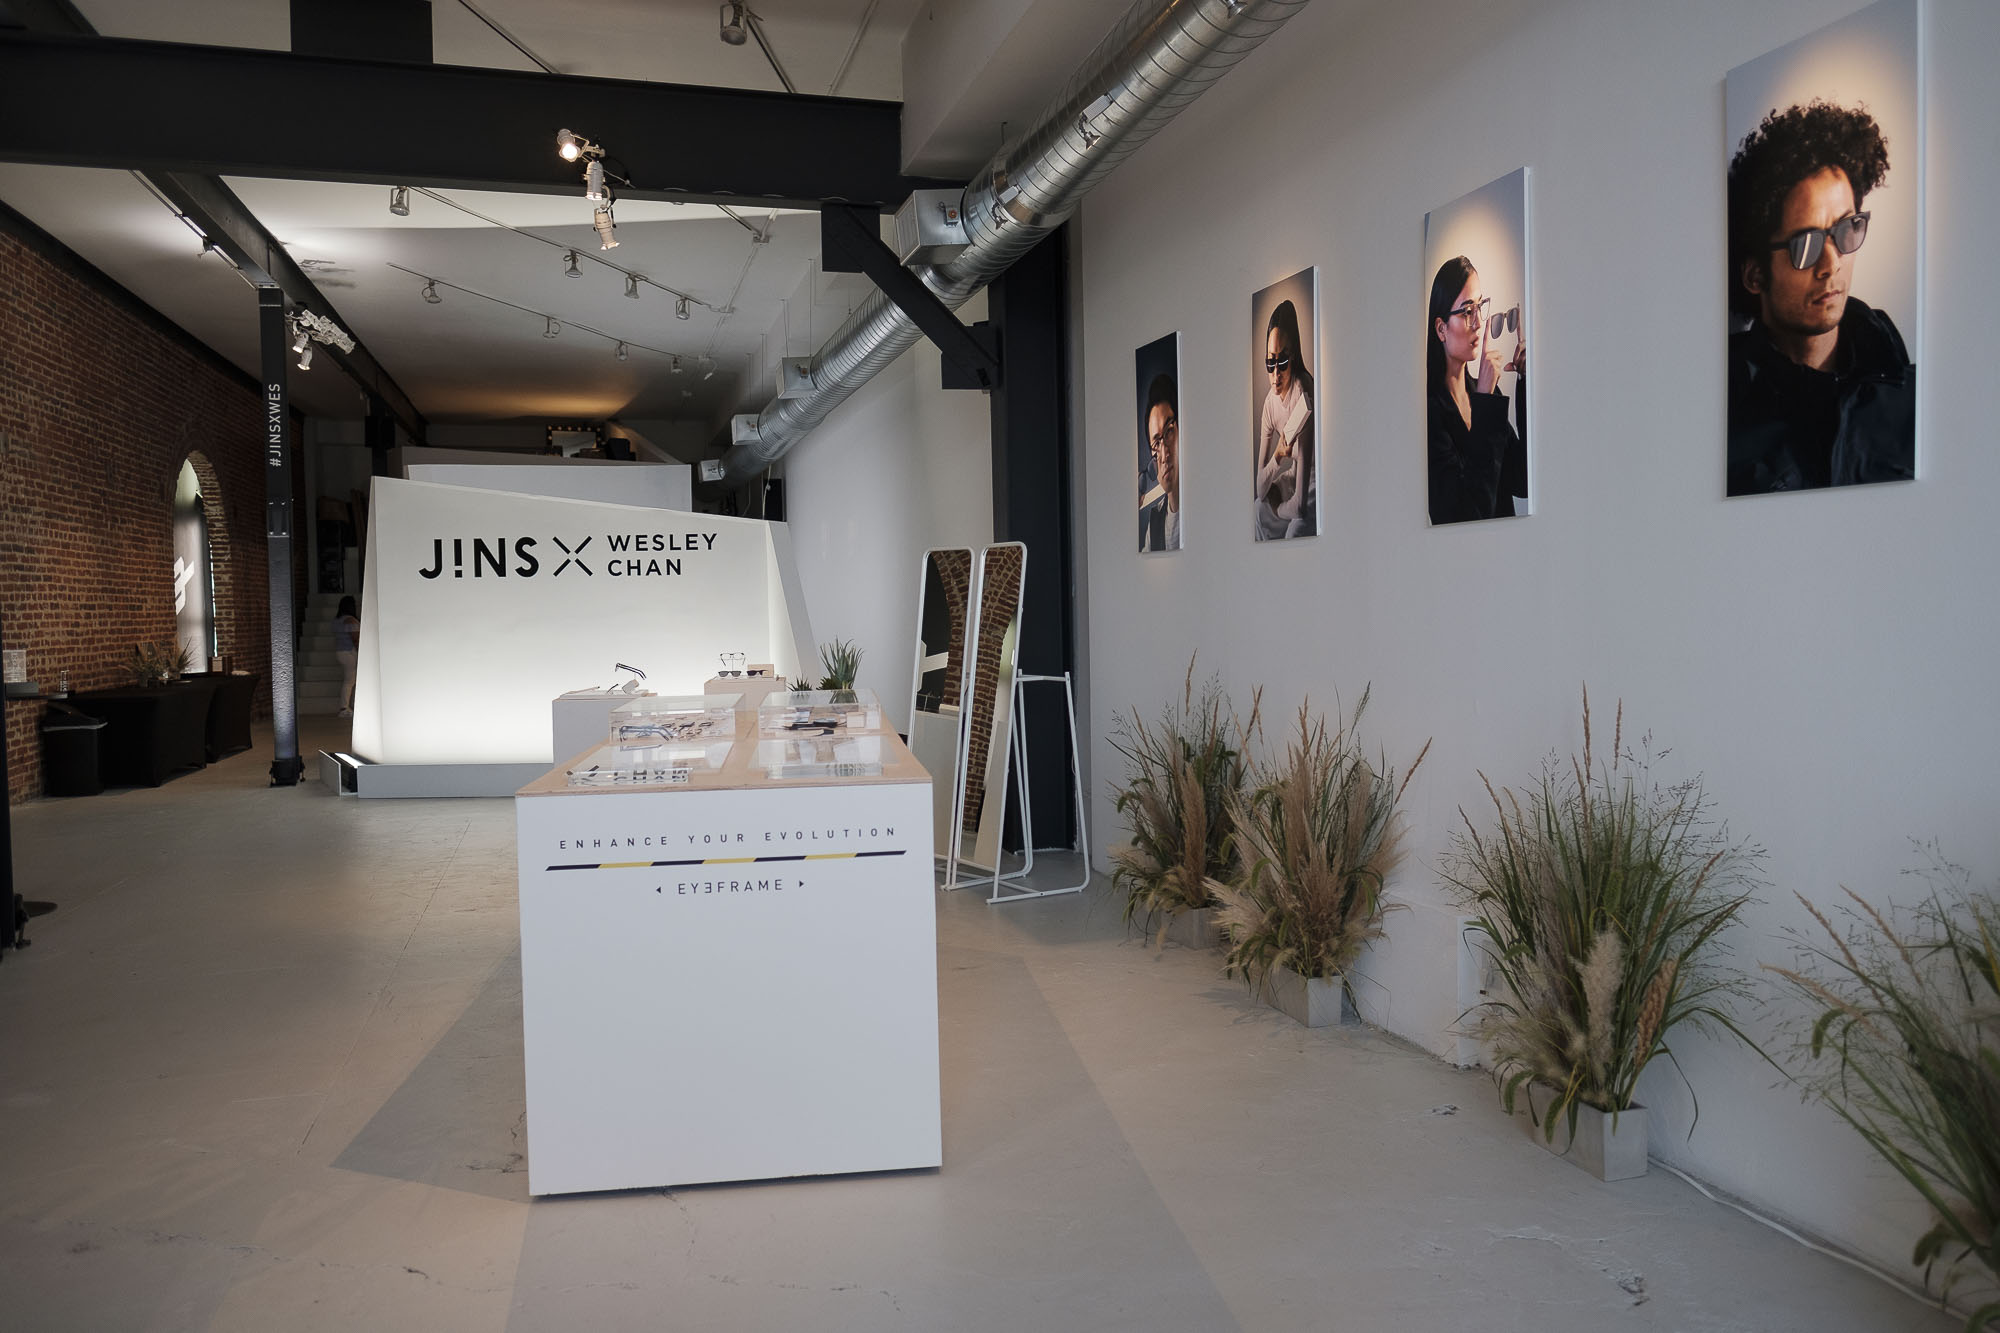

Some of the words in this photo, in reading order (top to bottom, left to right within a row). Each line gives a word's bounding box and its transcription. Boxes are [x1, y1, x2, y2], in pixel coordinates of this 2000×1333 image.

[268, 383, 282, 467] #JINSXWES
[606, 533, 718, 552] WESLEY
[606, 558, 682, 577] CHAN
[559, 836, 668, 850] ENHANCE
[688, 833, 744, 844] YOUR
[764, 827, 895, 841] EVOLUTION
